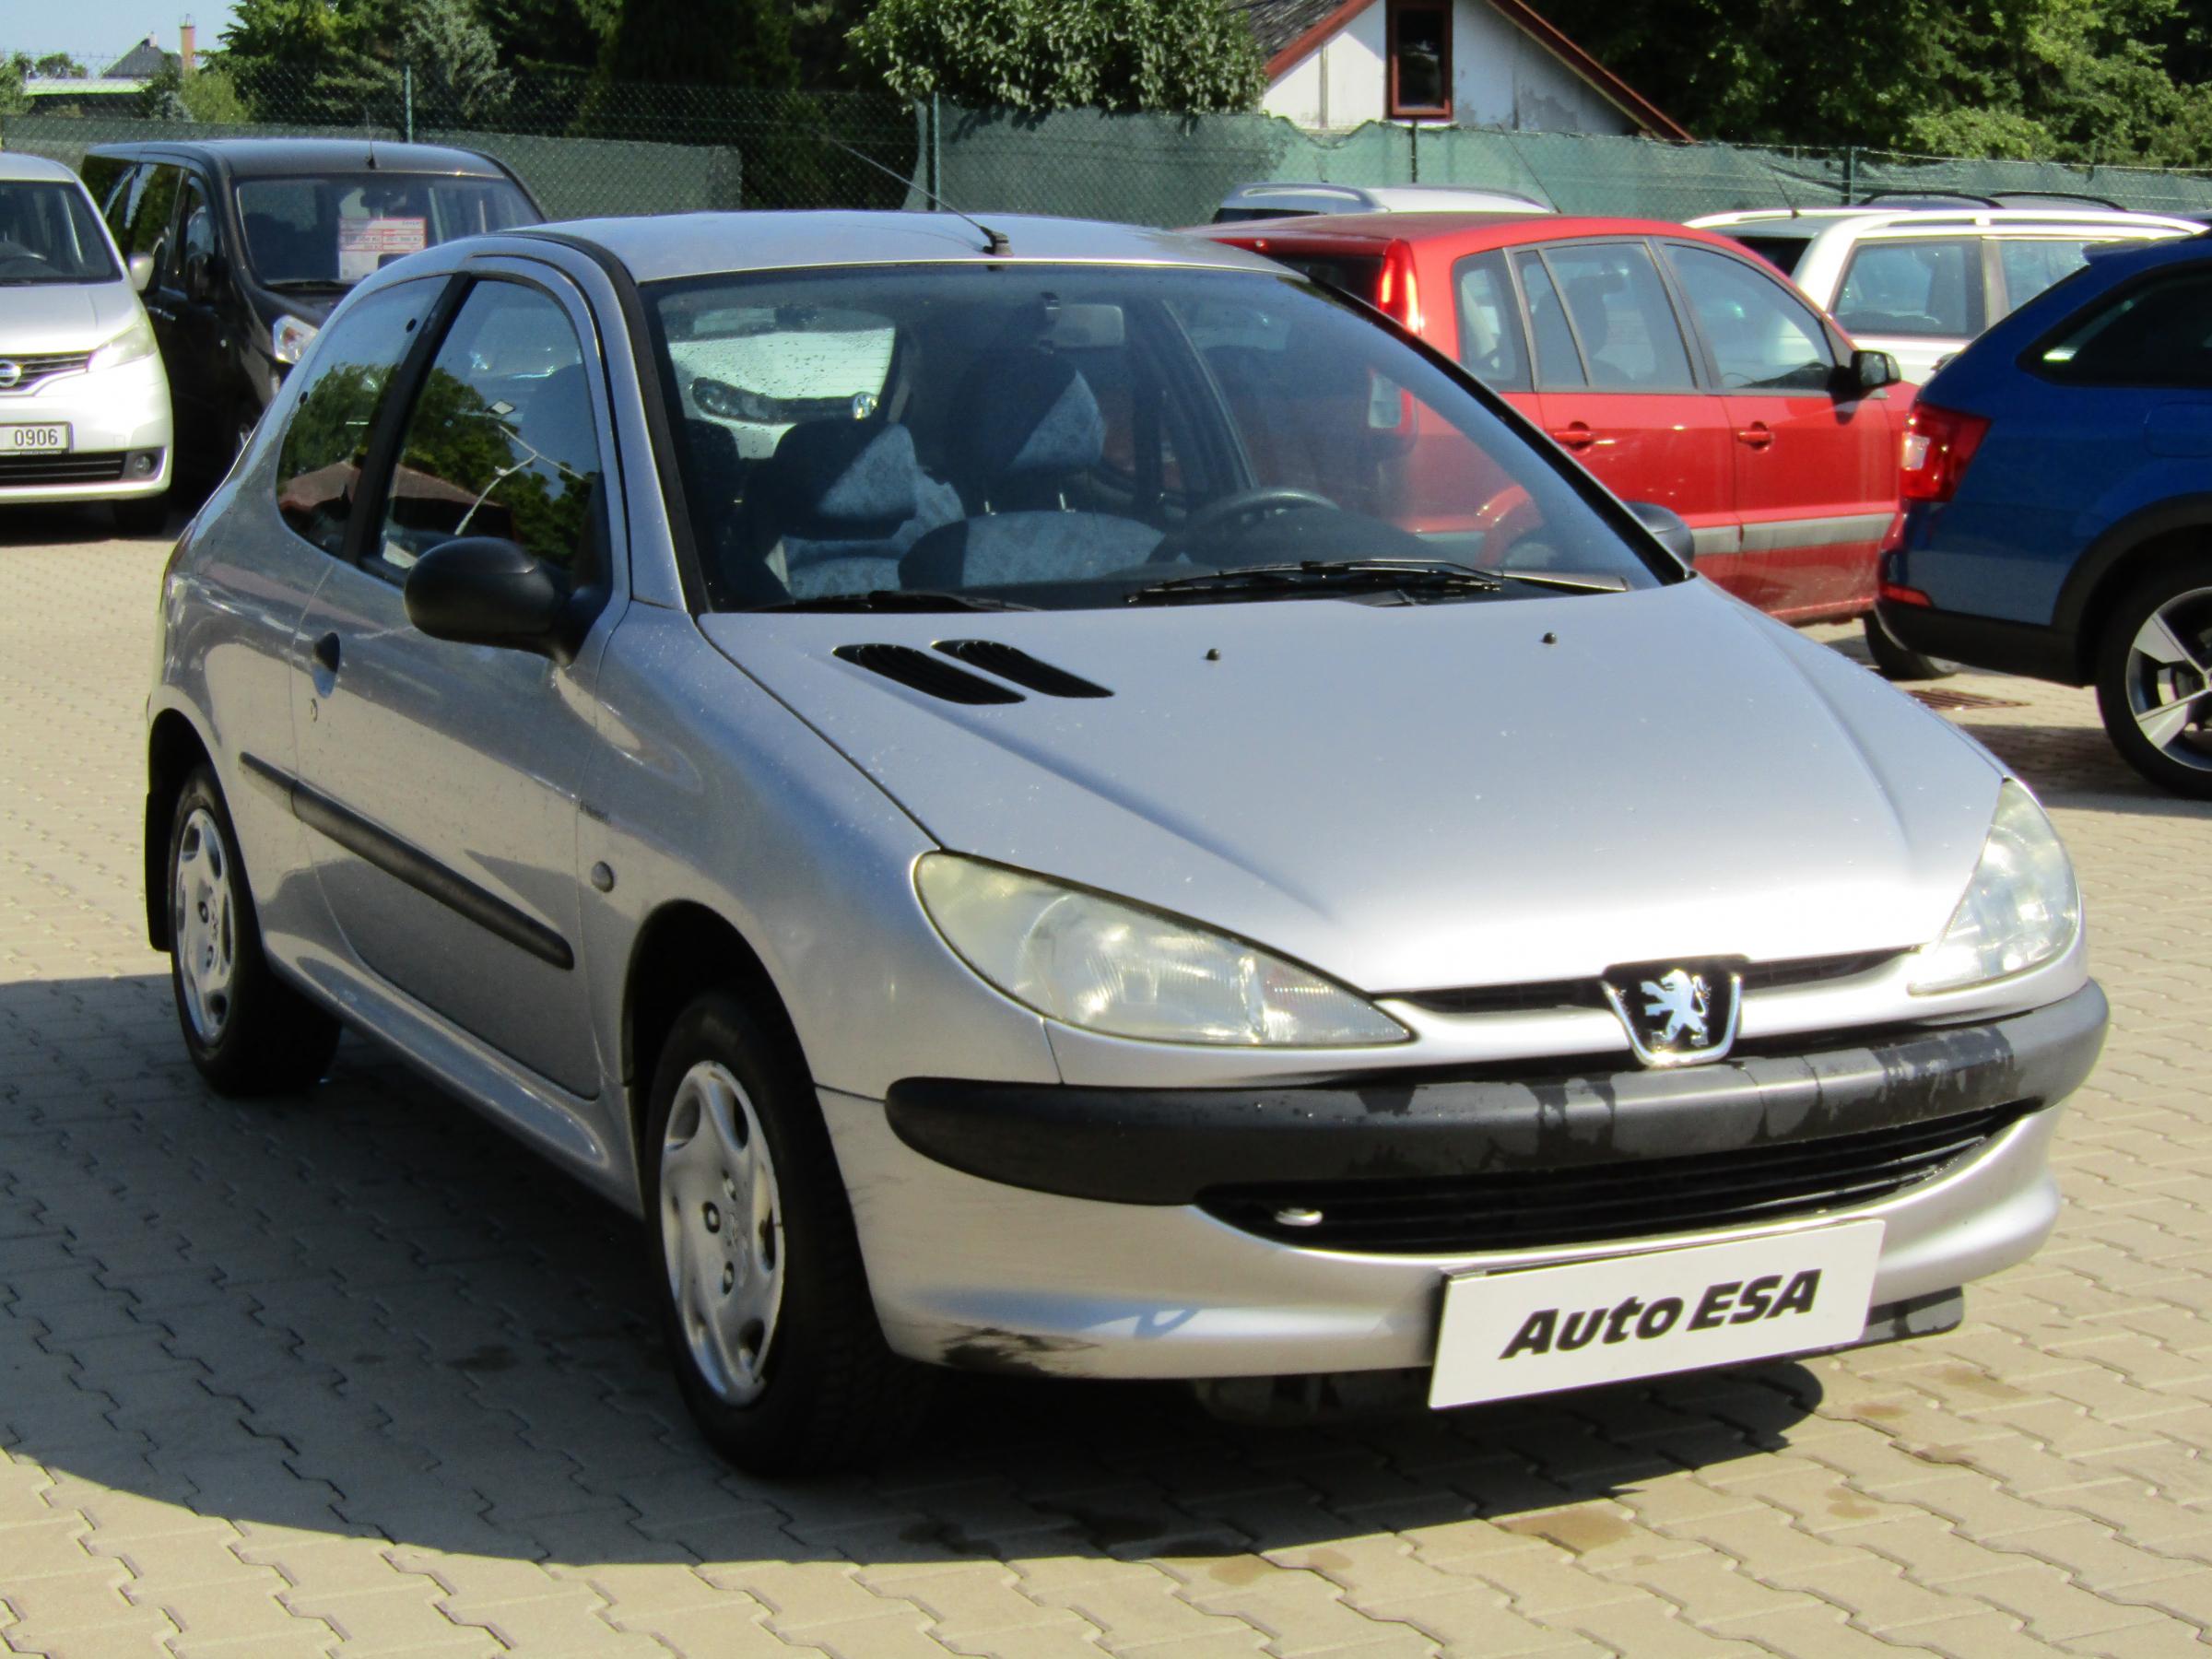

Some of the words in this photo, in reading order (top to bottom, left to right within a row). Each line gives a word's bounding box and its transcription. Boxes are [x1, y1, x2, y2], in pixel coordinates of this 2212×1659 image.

[14, 428, 58, 447] 0906
[1499, 1296, 1685, 1359] Auto
[1686, 1269, 1822, 1331] ESA
